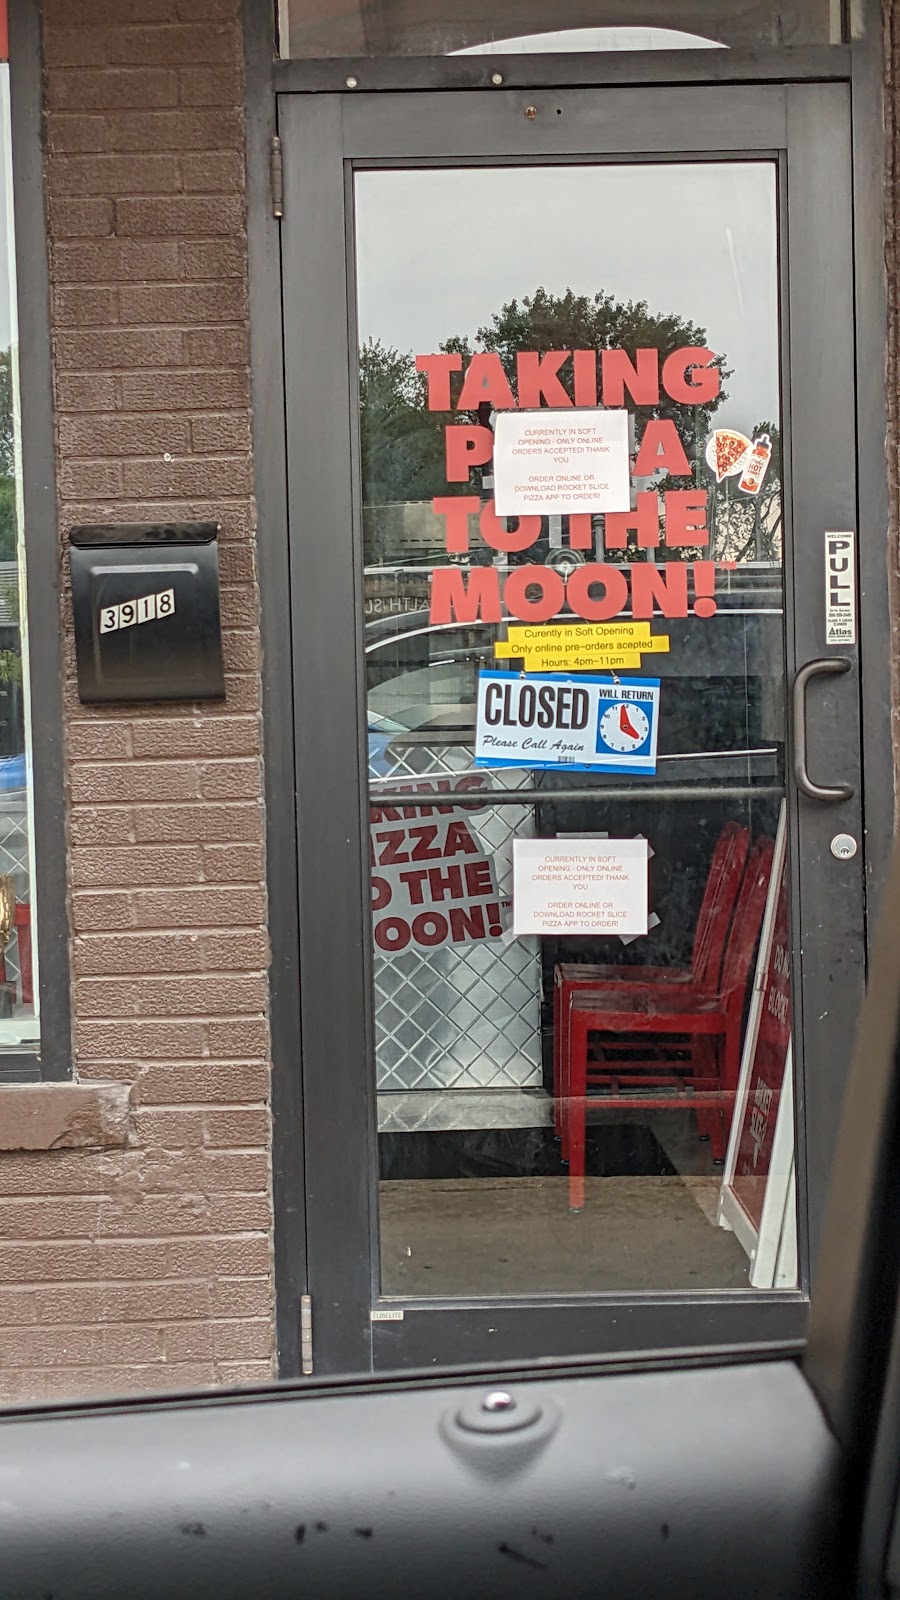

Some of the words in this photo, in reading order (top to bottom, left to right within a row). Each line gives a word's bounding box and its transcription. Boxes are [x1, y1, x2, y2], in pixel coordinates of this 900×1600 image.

[416, 346, 720, 411] TAKING
[518, 438, 551, 446] OPENING
[524, 428, 568, 436] CURRENTLY
[829, 541, 850, 606] PULL
[430, 560, 717, 624] MOON!
[104, 594, 171, 628] 3918
[524, 629, 562, 638] Curently
[575, 627, 594, 636] Soft
[596, 626, 634, 636] Opening
[511, 645, 532, 654] Only
[535, 643, 562, 652] online
[617, 640, 653, 650] acepted
[541, 659, 571, 667] Hours:
[574, 657, 624, 666] 4pm-11pm
[485, 683, 589, 730] CLOSED
[599, 688, 619, 698] WILL
[621, 690, 654, 700] RETURN
[482, 735, 517, 747] Please
[521, 737, 547, 750] Call
[550, 739, 584, 753] Again
[400, 861, 493, 905] THE
[373, 902, 503, 952] OON!
